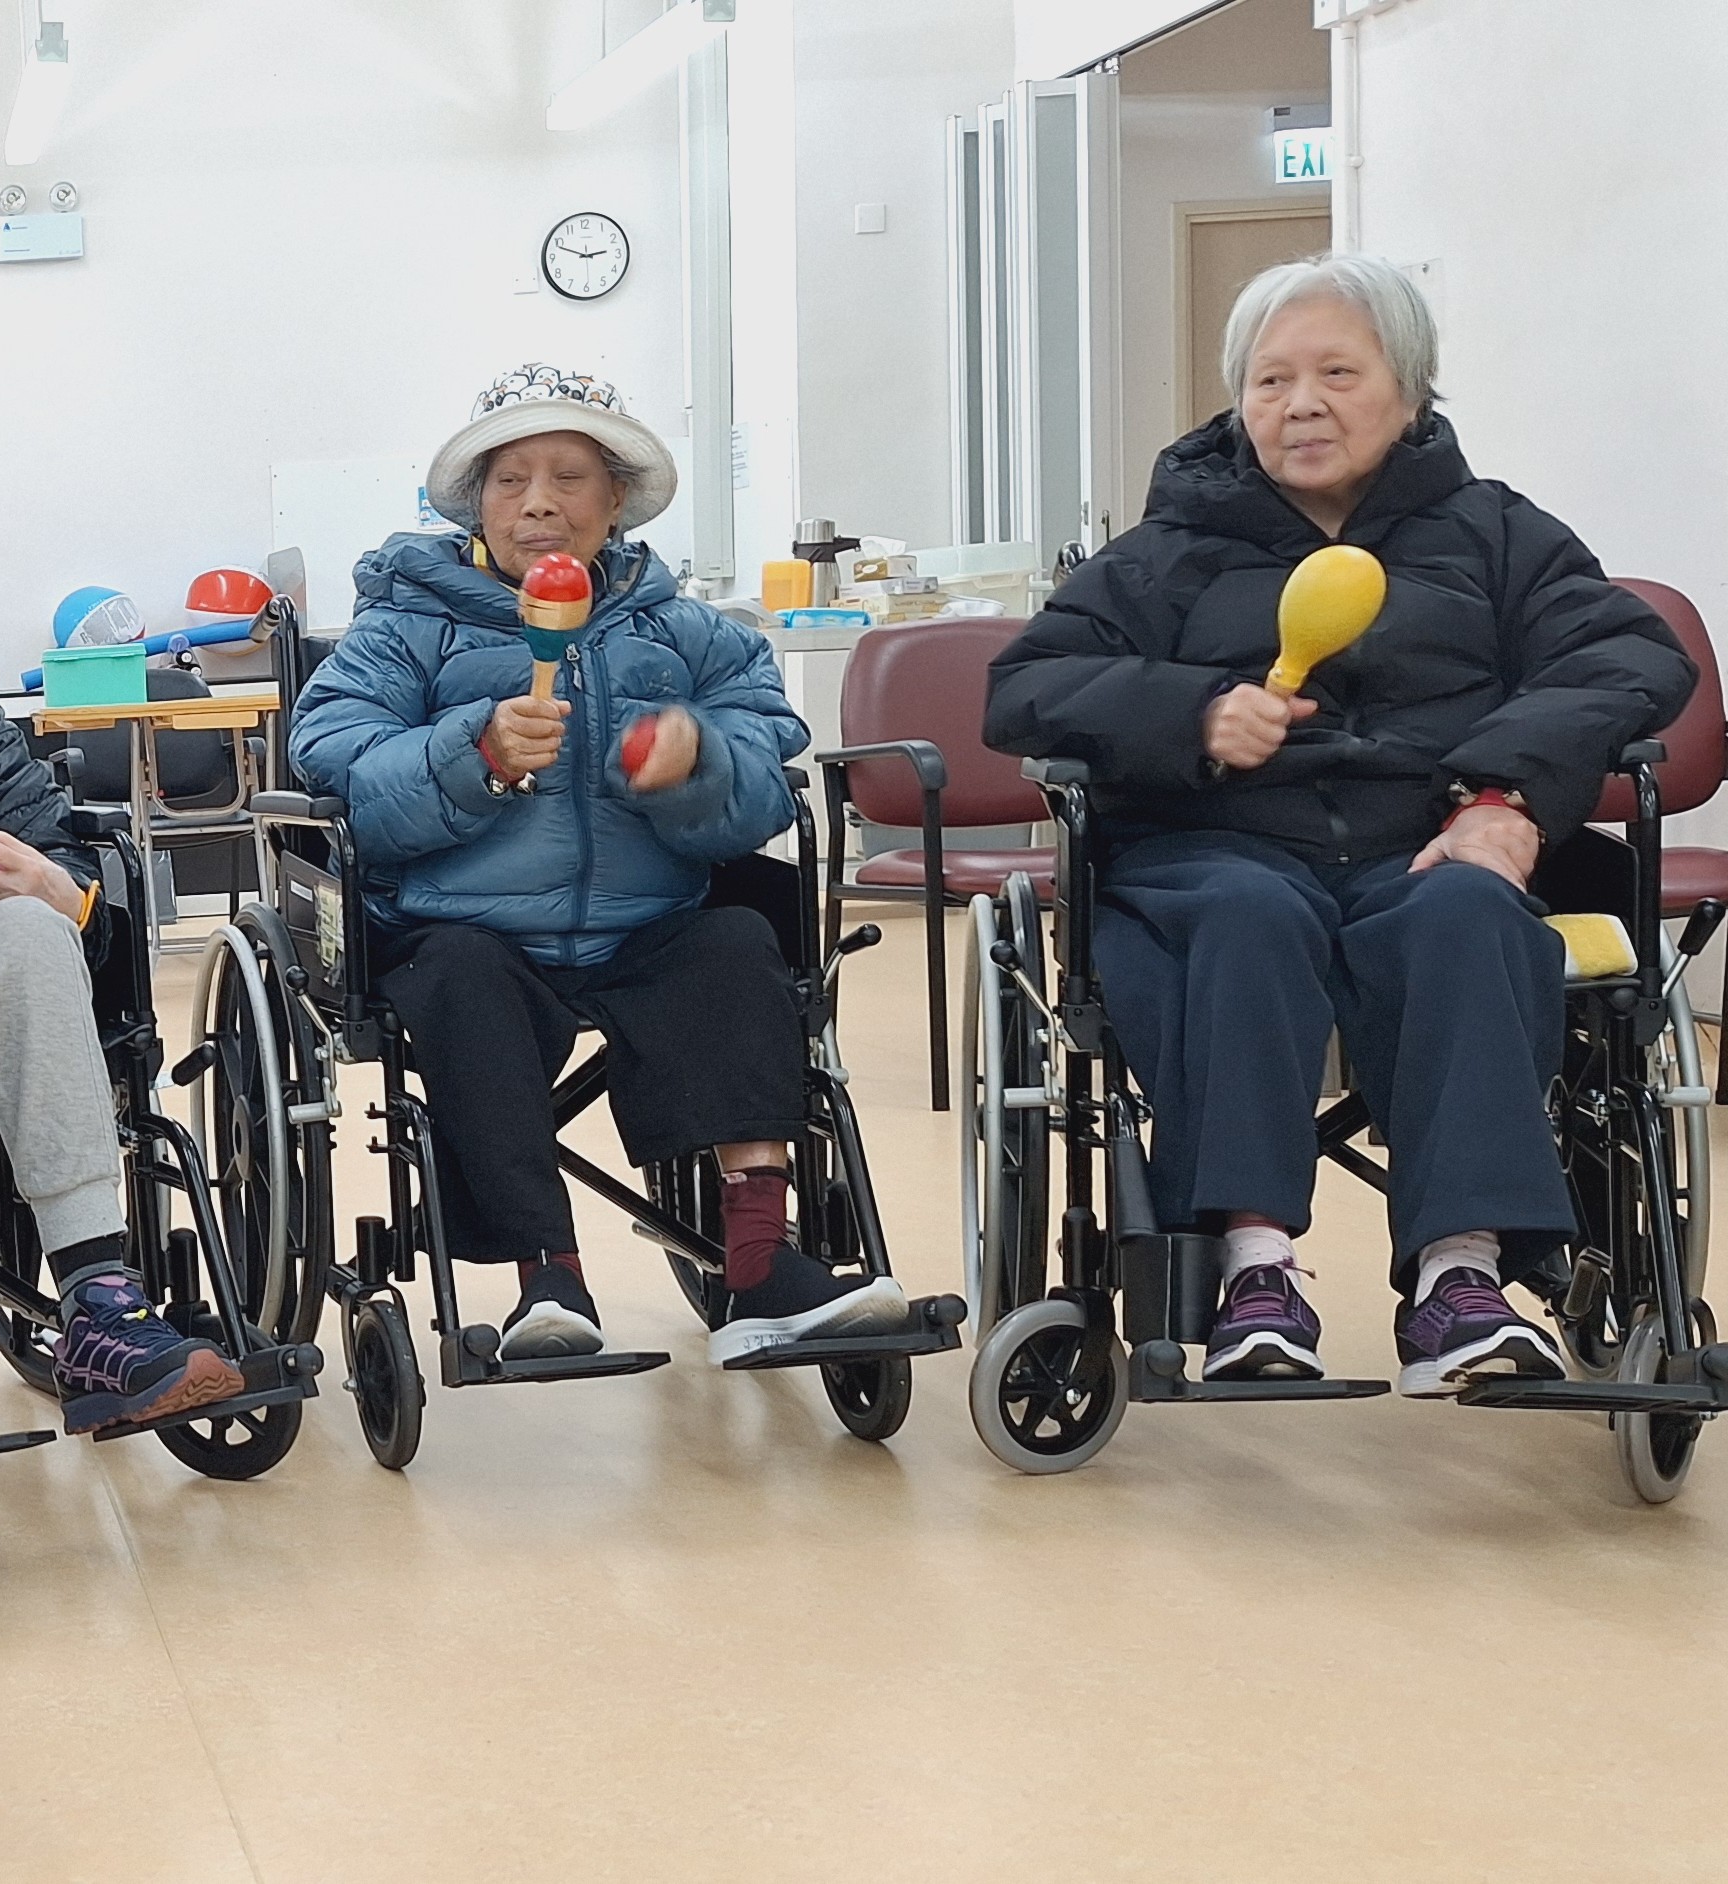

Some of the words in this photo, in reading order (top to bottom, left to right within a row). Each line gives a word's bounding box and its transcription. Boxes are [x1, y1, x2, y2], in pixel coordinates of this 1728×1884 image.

[1283, 139, 1327, 178] EXI
[580, 219, 590, 229] 12
[566, 225, 574, 235] 11
[610, 233, 617, 243] 2
[549, 253, 556, 264] 9
[615, 248, 622, 259] 3
[555, 268, 561, 278] 8
[611, 264, 617, 274] 4
[567, 279, 574, 289] 7
[600, 276, 607, 287] 5
[583, 282, 590, 292] 6
